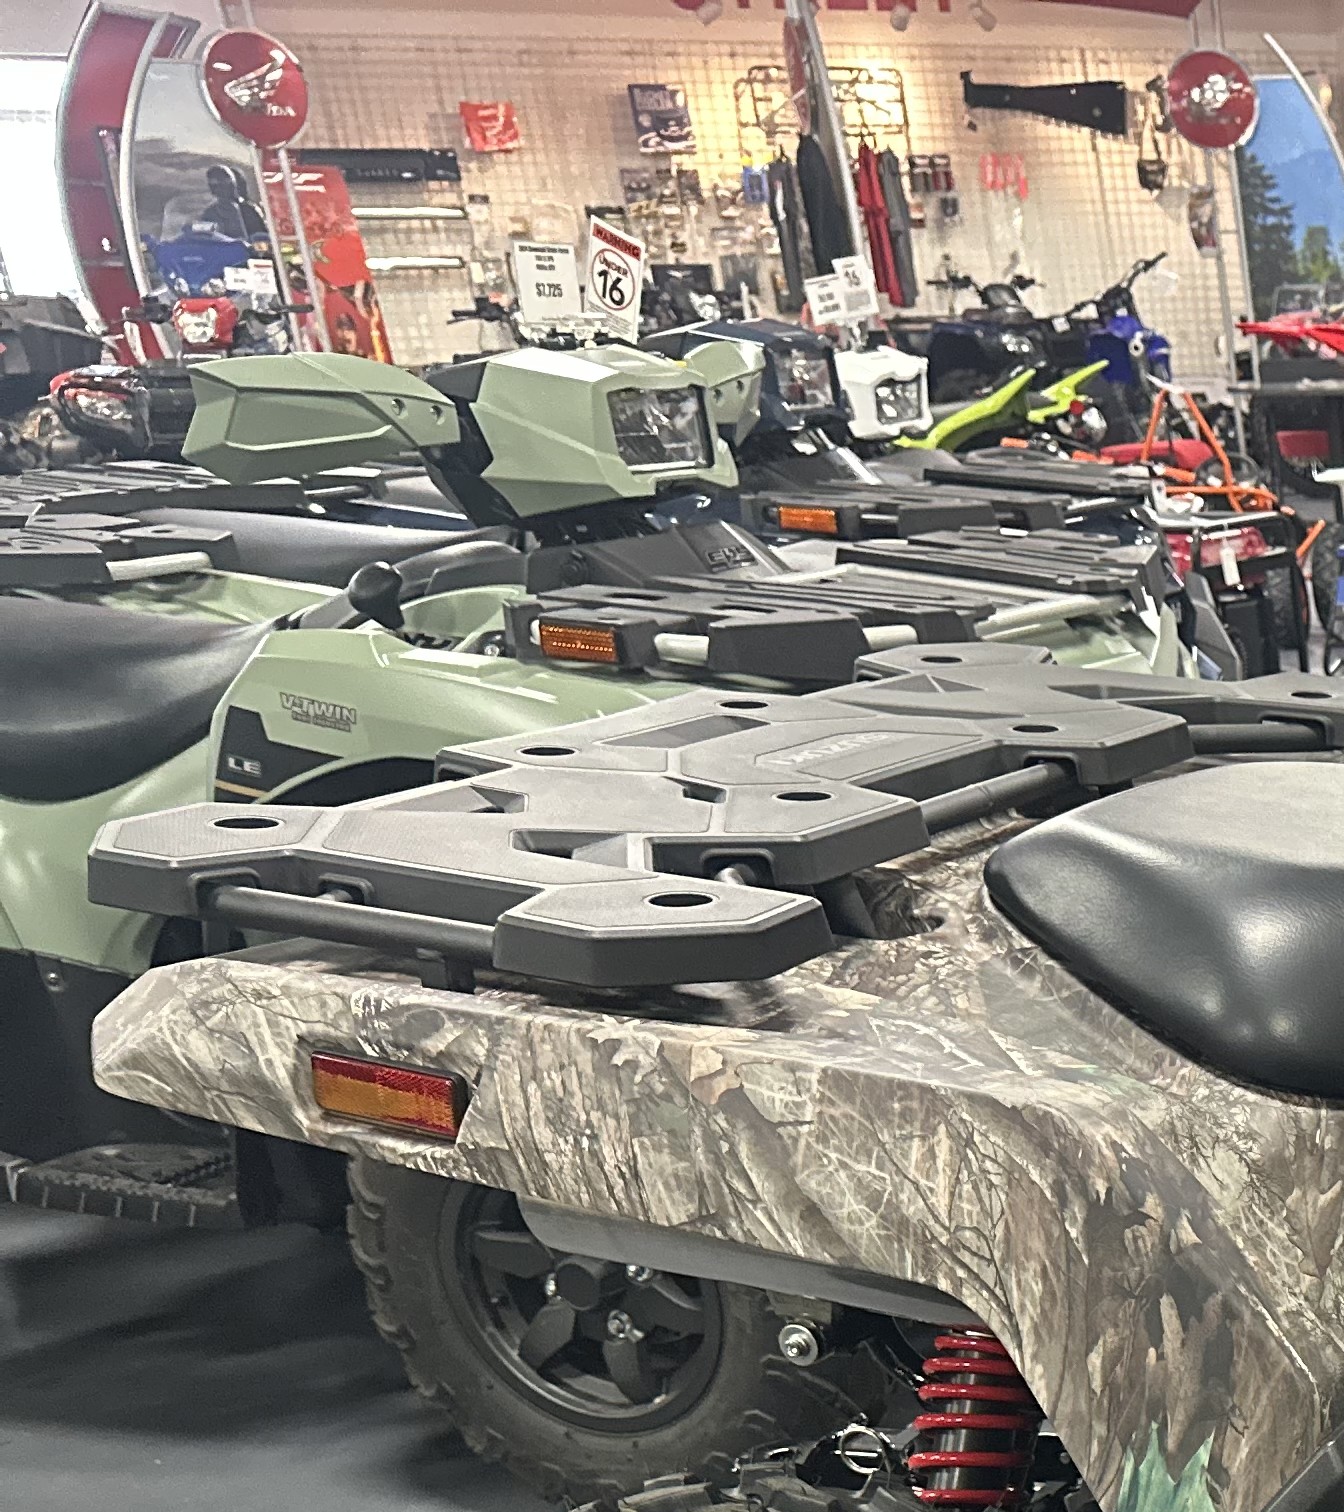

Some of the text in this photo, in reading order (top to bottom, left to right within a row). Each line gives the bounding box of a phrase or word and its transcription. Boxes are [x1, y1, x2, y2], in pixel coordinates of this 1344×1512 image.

[597, 268, 626, 306] 16
[280, 692, 357, 725] V-TWIN
[227, 756, 262, 778] LE
